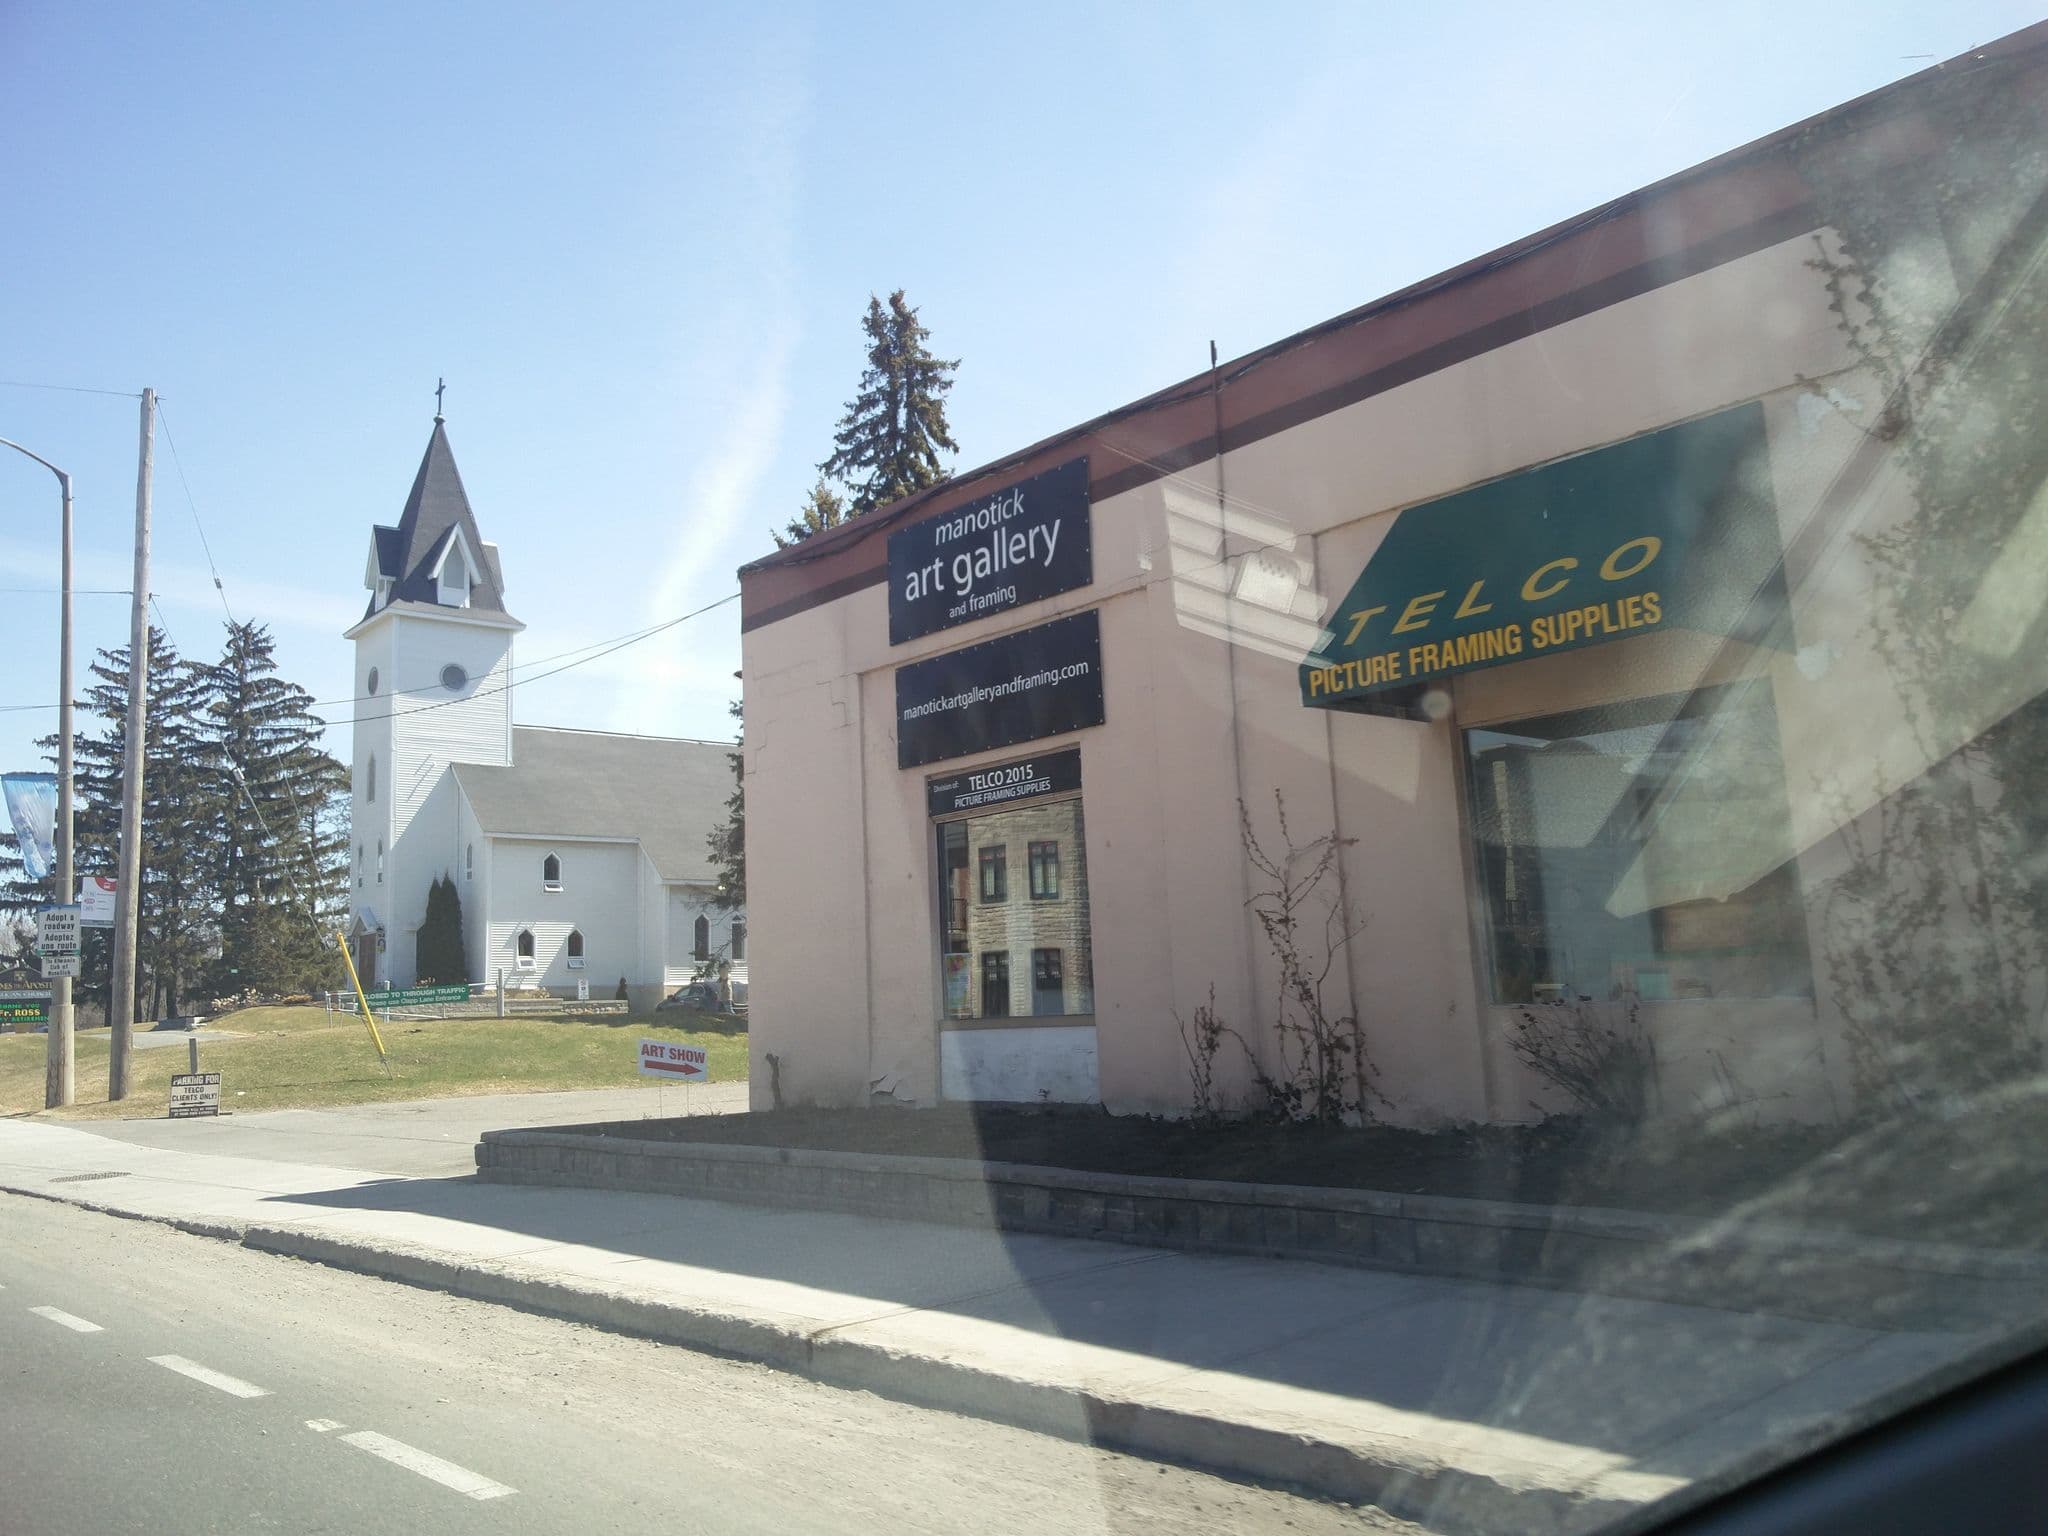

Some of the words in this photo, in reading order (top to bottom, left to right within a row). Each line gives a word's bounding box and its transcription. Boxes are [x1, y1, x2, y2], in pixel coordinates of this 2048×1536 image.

[935, 488, 1025, 546] manotick
[905, 557, 945, 601] art
[952, 519, 1061, 596] gallery
[949, 604, 967, 618] and
[969, 585, 1017, 612] framing
[1343, 536, 1662, 646] TELCO
[1309, 652, 1401, 696] PICTURE
[1408, 624, 1522, 675] FRAMING
[1531, 591, 1662, 649] SUPPLIES
[903, 661, 1089, 720] manotickartgalleryandframing.com
[968, 771, 1004, 791] TELCO
[1005, 764, 1034, 784] 2015
[954, 794, 983, 808] PICTURE
[983, 786, 1016, 802] FRAMING
[1015, 779, 1051, 796] SUPPLIES
[44, 922, 75, 930] roadway
[46, 913, 67, 921] Adopt
[45, 933, 74, 942] Adoptez
[15, 1008, 41, 1017] ROSS
[641, 1044, 665, 1058] ART
[669, 1047, 705, 1064] SHOW
[205, 1075, 219, 1084] FOR
